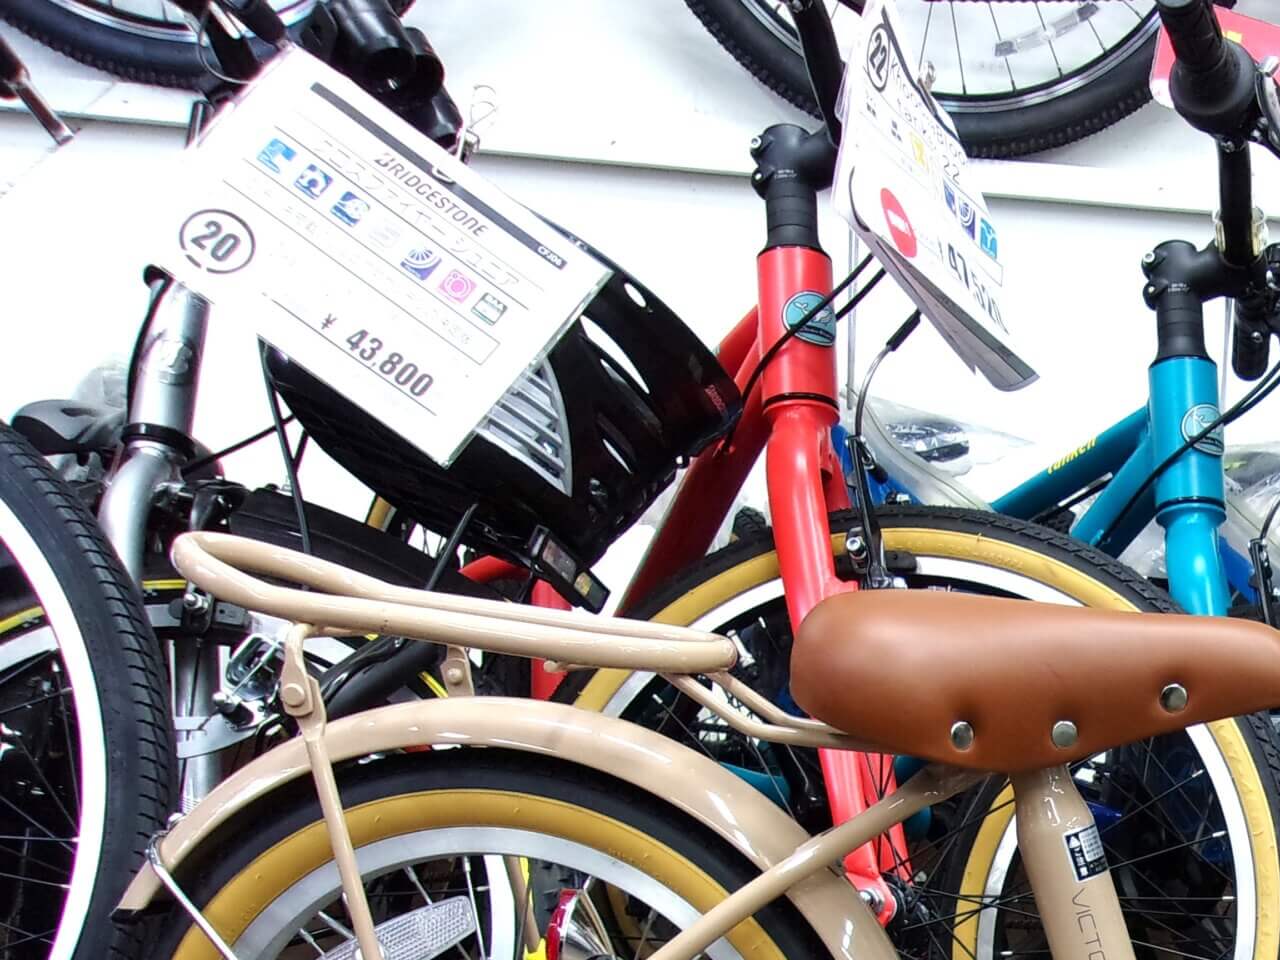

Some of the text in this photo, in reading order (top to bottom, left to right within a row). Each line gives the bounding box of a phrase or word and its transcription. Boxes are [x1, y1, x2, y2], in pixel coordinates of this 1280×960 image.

[868, 31, 888, 83] 22
[374, 152, 490, 238] BRIDGESTONE
[191, 219, 241, 262] 20
[345, 328, 436, 398] 43,800
